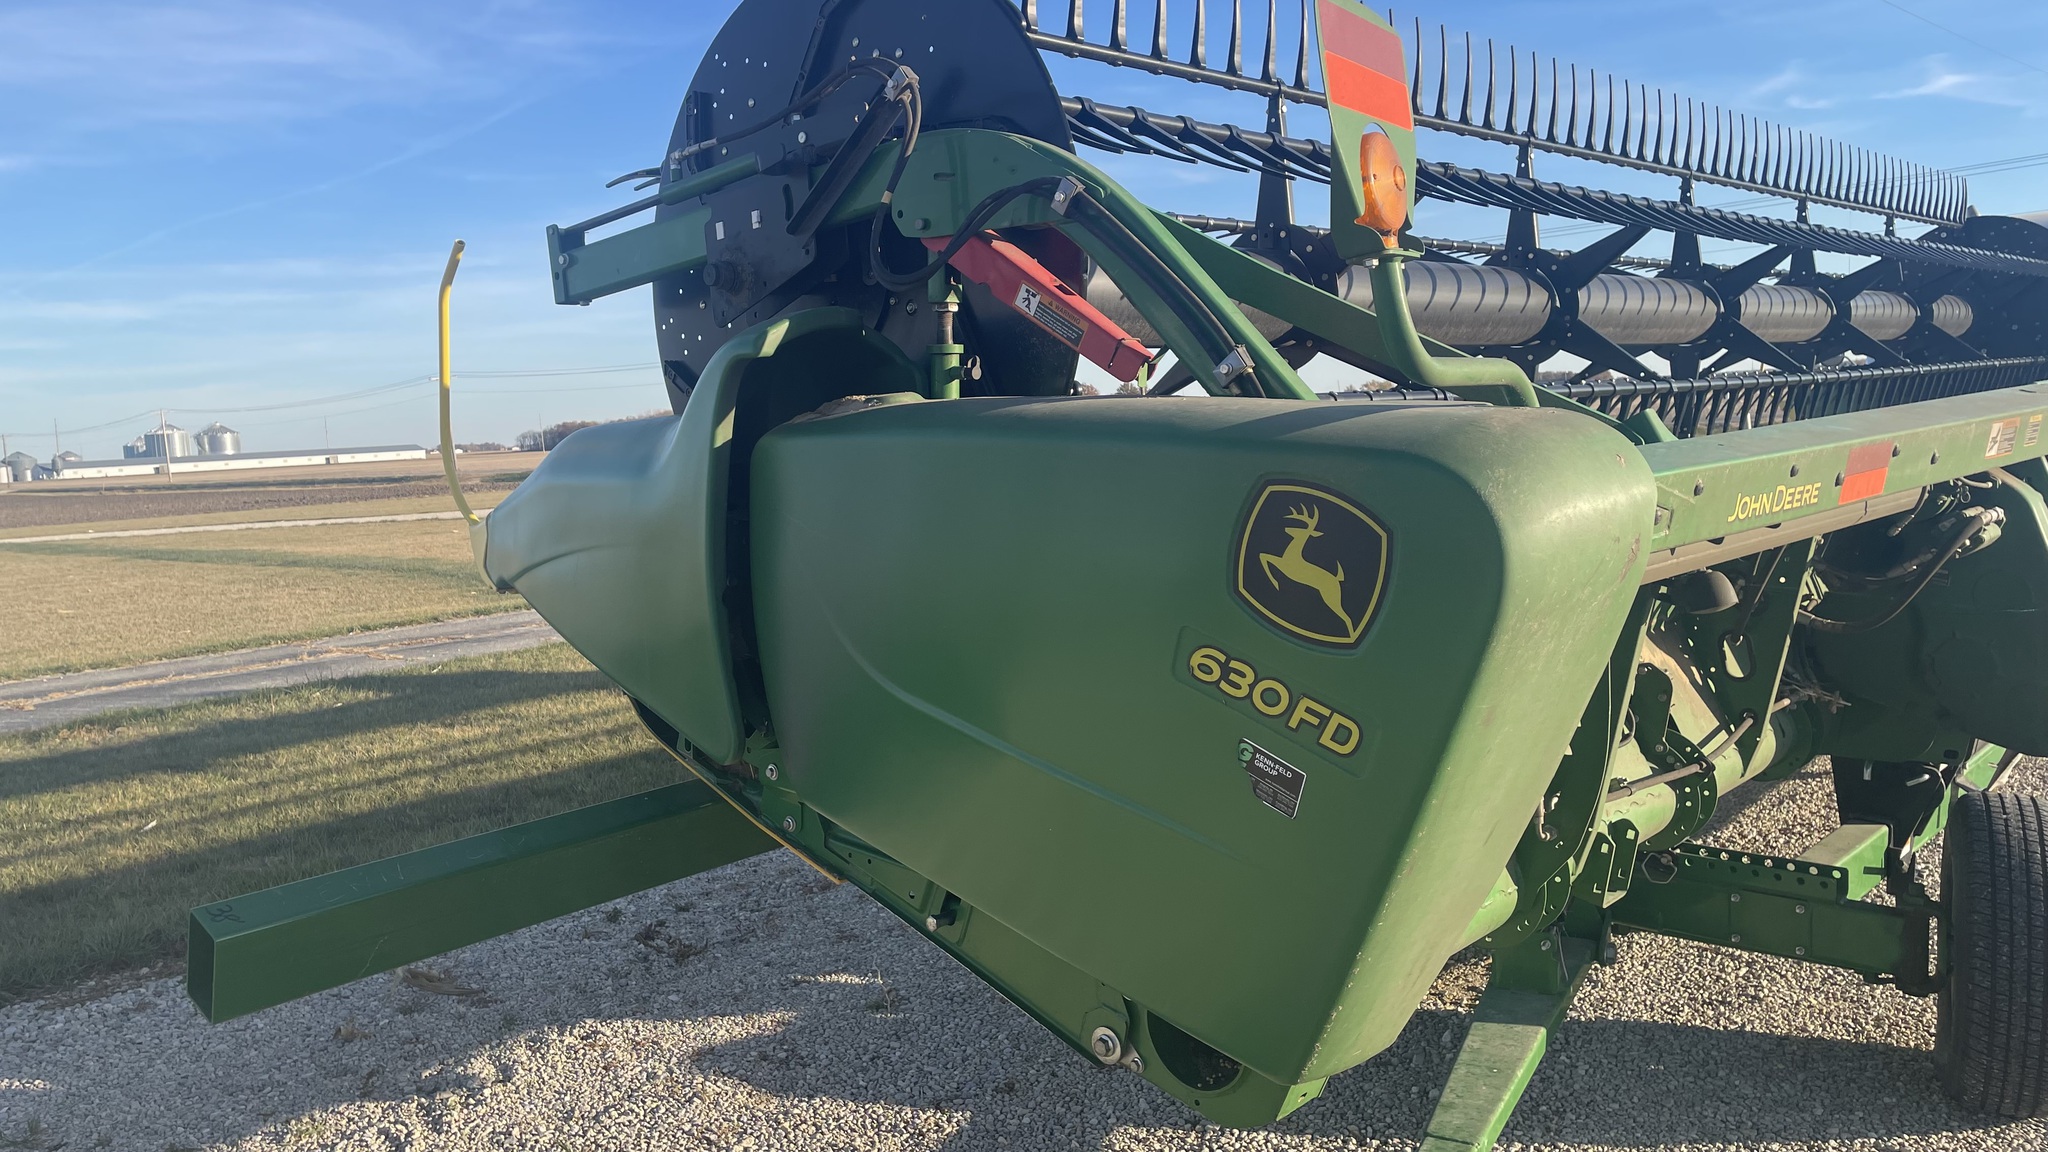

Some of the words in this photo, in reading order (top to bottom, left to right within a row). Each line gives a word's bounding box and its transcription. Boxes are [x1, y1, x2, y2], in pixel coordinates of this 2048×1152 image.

[1055, 302, 1081, 325] WARNING
[1727, 492, 1774, 522] JOHN
[1772, 482, 1822, 513] DEERE
[1188, 645, 1362, 757] 630FD
[1254, 759, 1278, 776] GROUP
